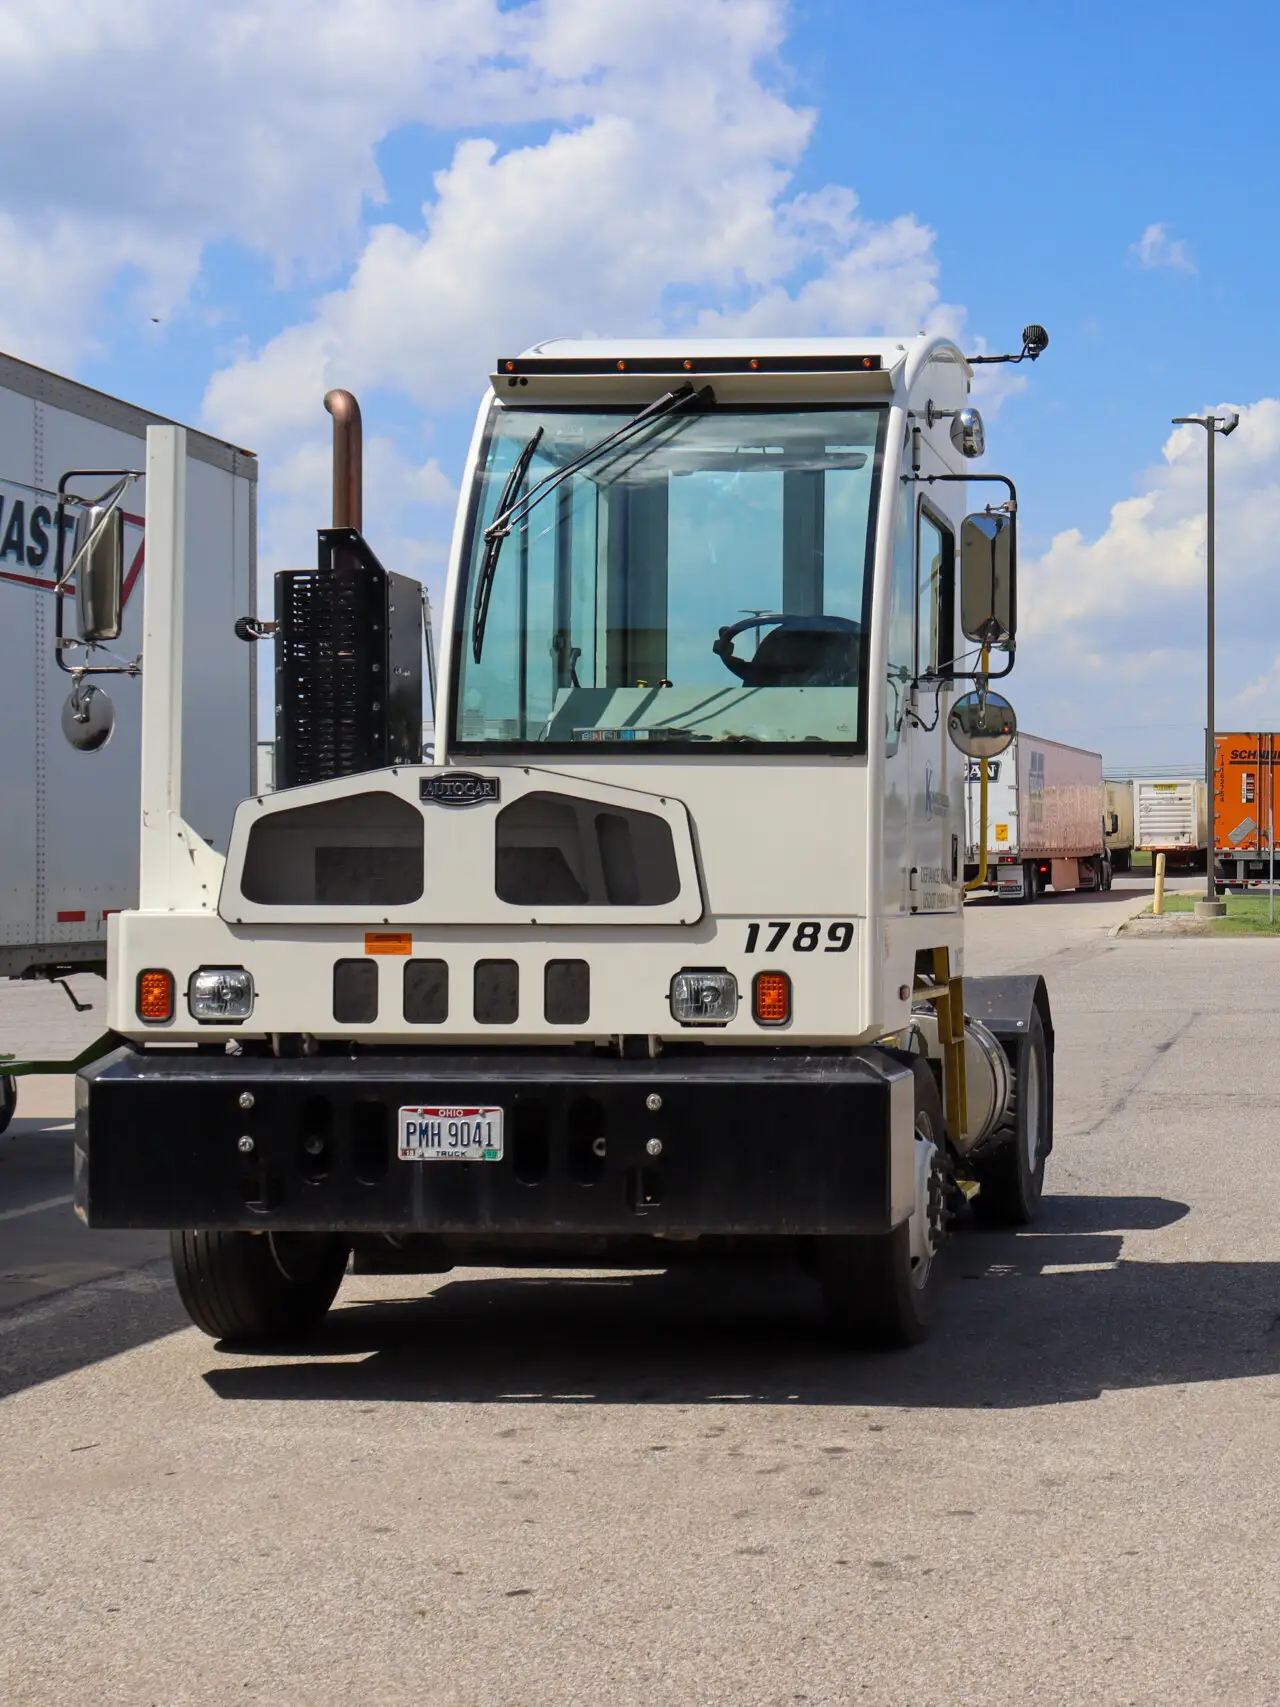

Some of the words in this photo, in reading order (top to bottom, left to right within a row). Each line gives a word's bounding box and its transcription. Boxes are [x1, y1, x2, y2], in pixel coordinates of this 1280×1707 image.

[0, 494, 79, 576] AST
[423, 781, 494, 795] AUTOCAR
[744, 921, 855, 954] 1789
[438, 1109, 464, 1117] OHIO
[405, 1120, 442, 1148] PMH
[447, 1120, 494, 1148] 9041
